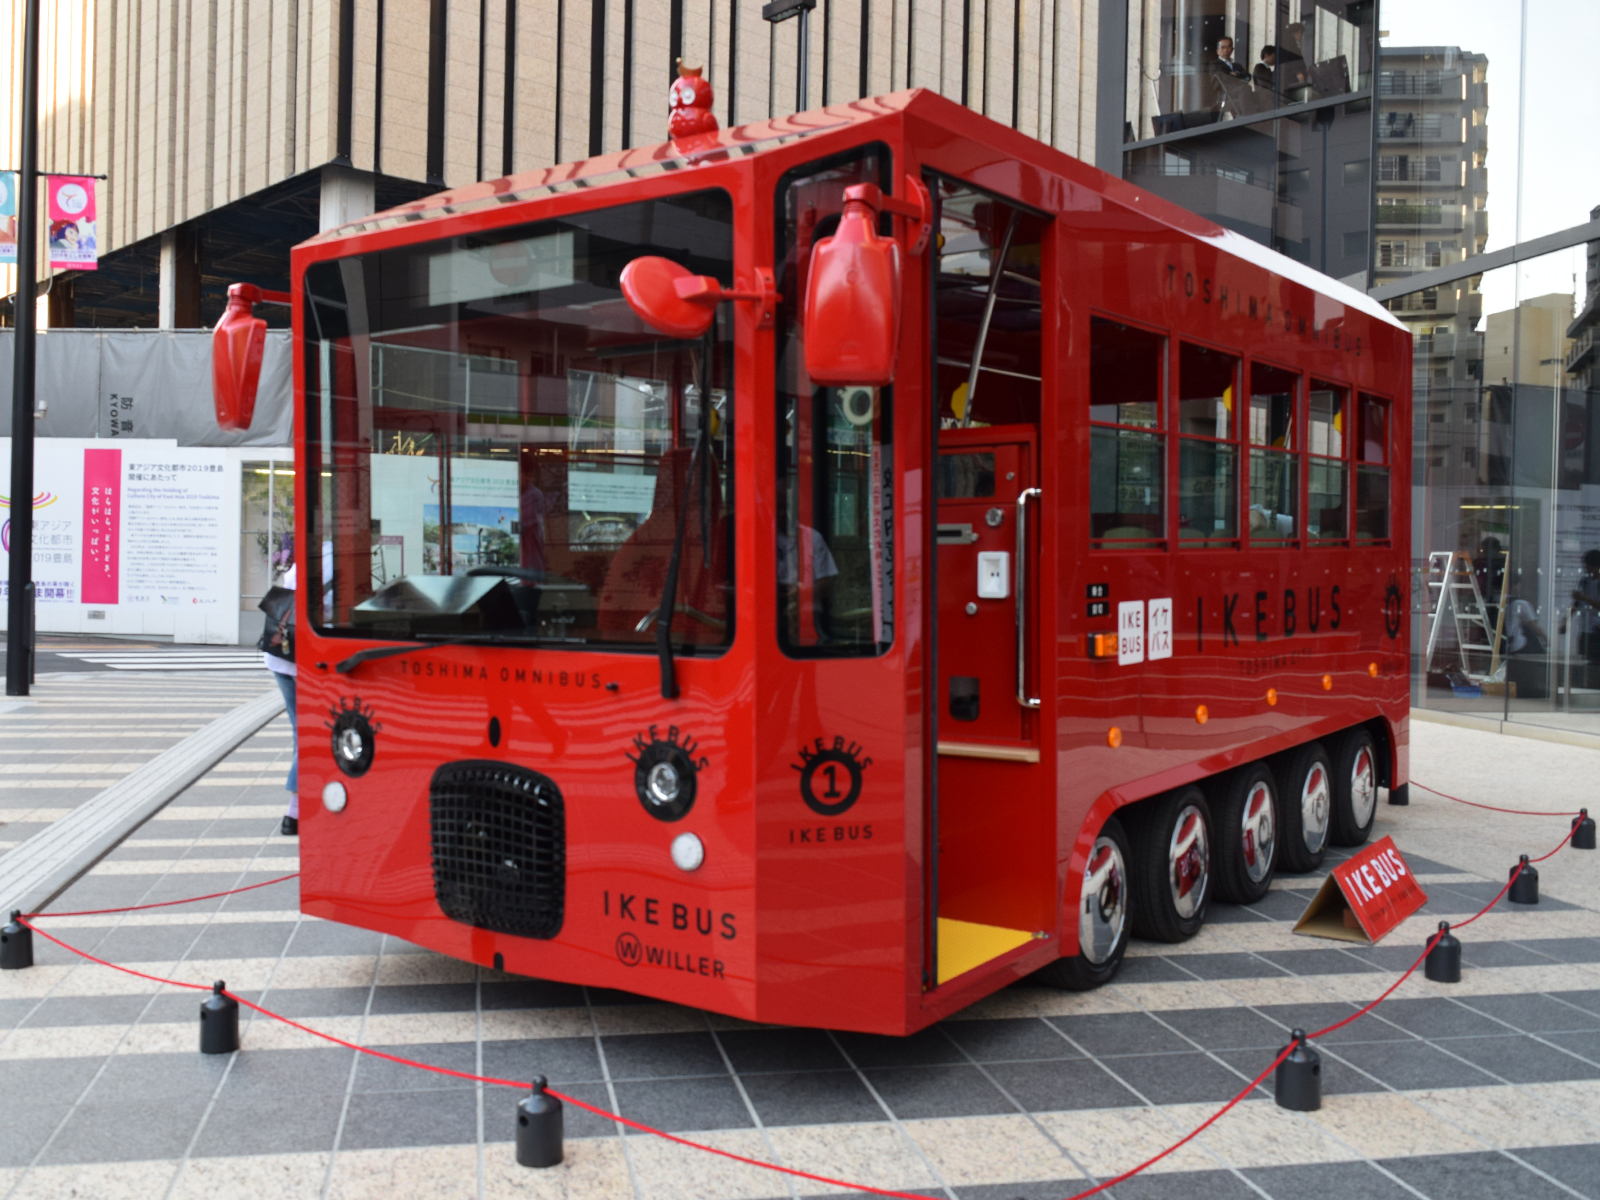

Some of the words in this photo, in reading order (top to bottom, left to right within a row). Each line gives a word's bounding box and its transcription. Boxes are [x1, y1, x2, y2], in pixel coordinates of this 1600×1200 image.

[1167, 264, 1273, 327] TOSHIMA
[1285, 308, 1362, 357] OMNIBUS
[110, 393, 119, 436] KYOWA
[33, 553, 73, 564] 019豊島
[1122, 610, 1141, 629] IKE
[1152, 606, 1169, 627] イケ
[1122, 636, 1141, 655] BUS
[1151, 630, 1169, 652] バス
[400, 660, 488, 680] TOSHIMA
[500, 667, 602, 688] OMNIBUS
[625, 724, 709, 772] IKEBUS
[791, 735, 873, 773] IKEBUS
[823, 765, 841, 798] 1
[646, 945, 725, 979] WILLER
